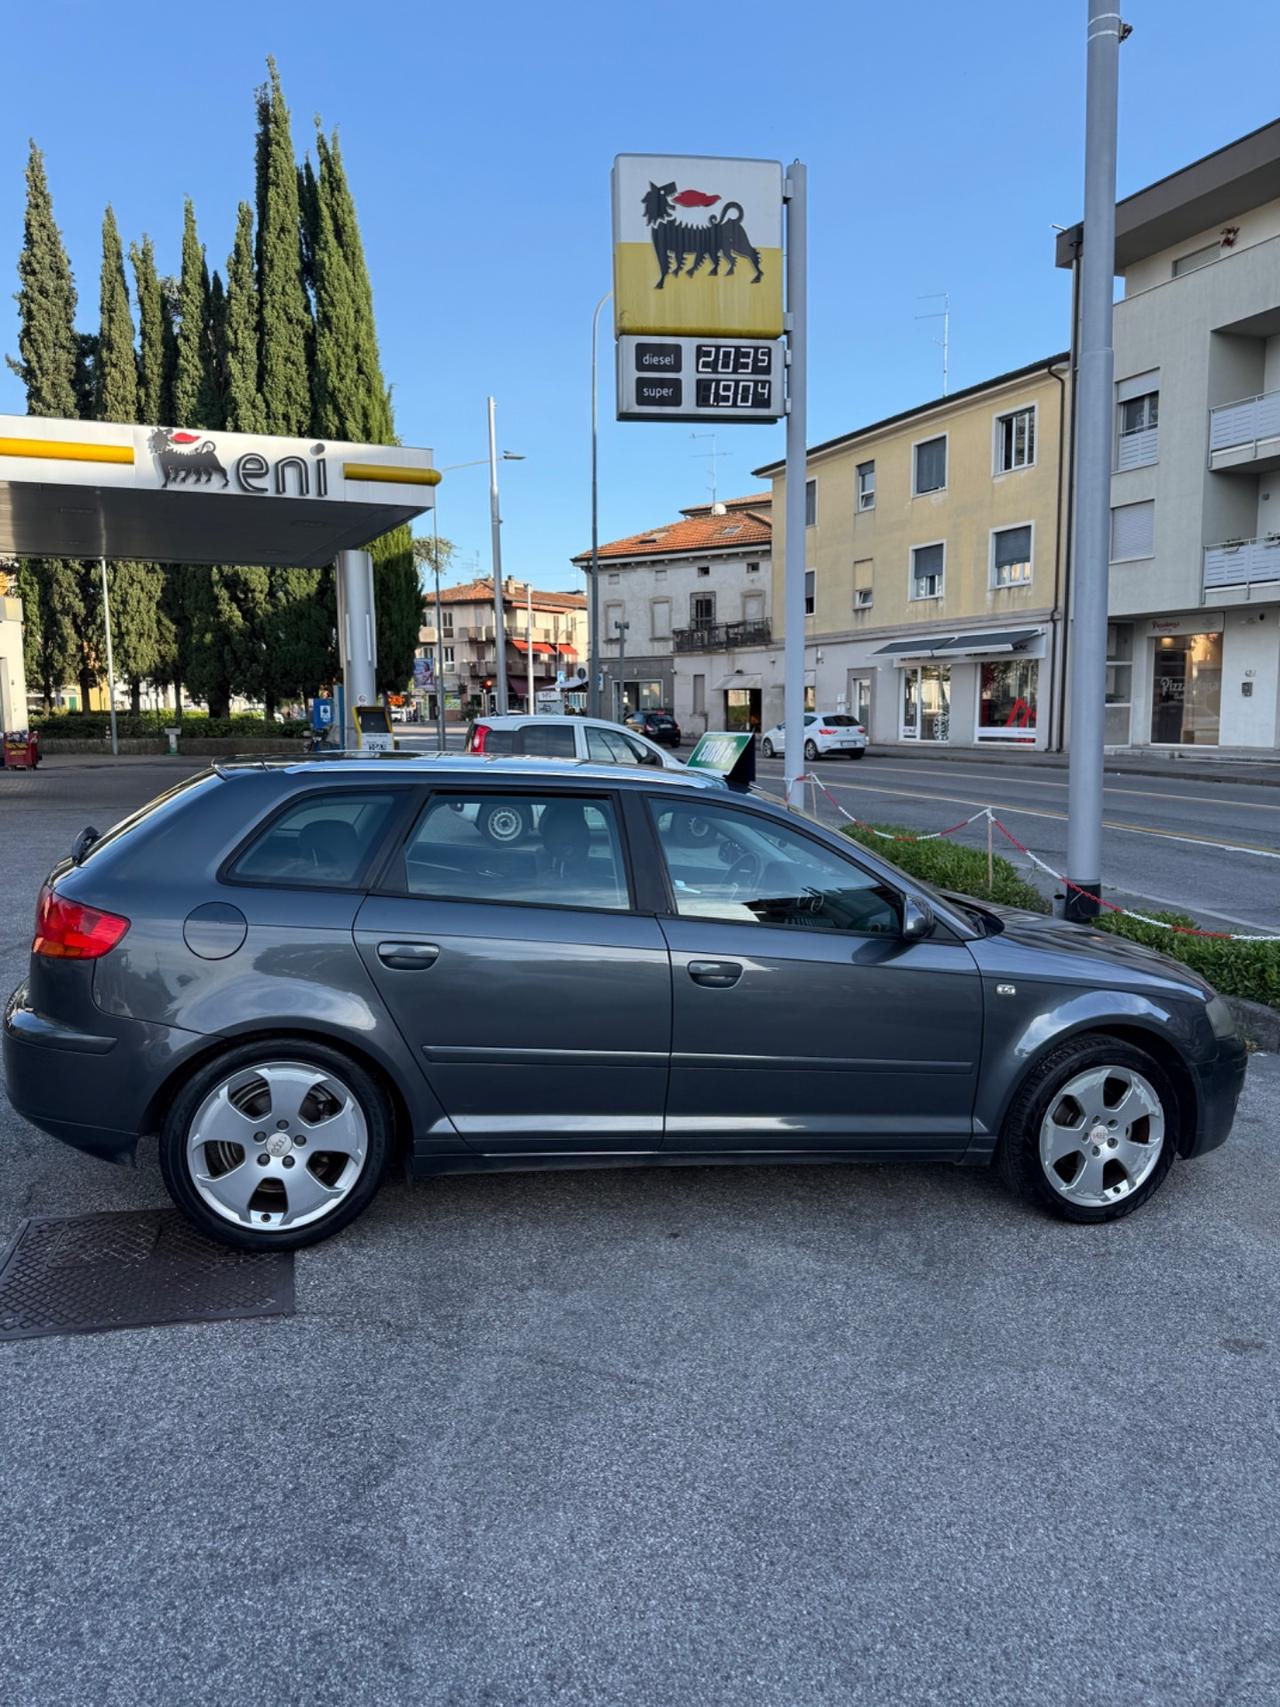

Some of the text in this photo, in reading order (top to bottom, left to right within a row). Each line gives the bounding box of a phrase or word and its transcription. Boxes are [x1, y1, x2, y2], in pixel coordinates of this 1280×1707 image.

[642, 353, 675, 366] diesel
[642, 386, 674, 399] super
[236, 442, 328, 497] eni
